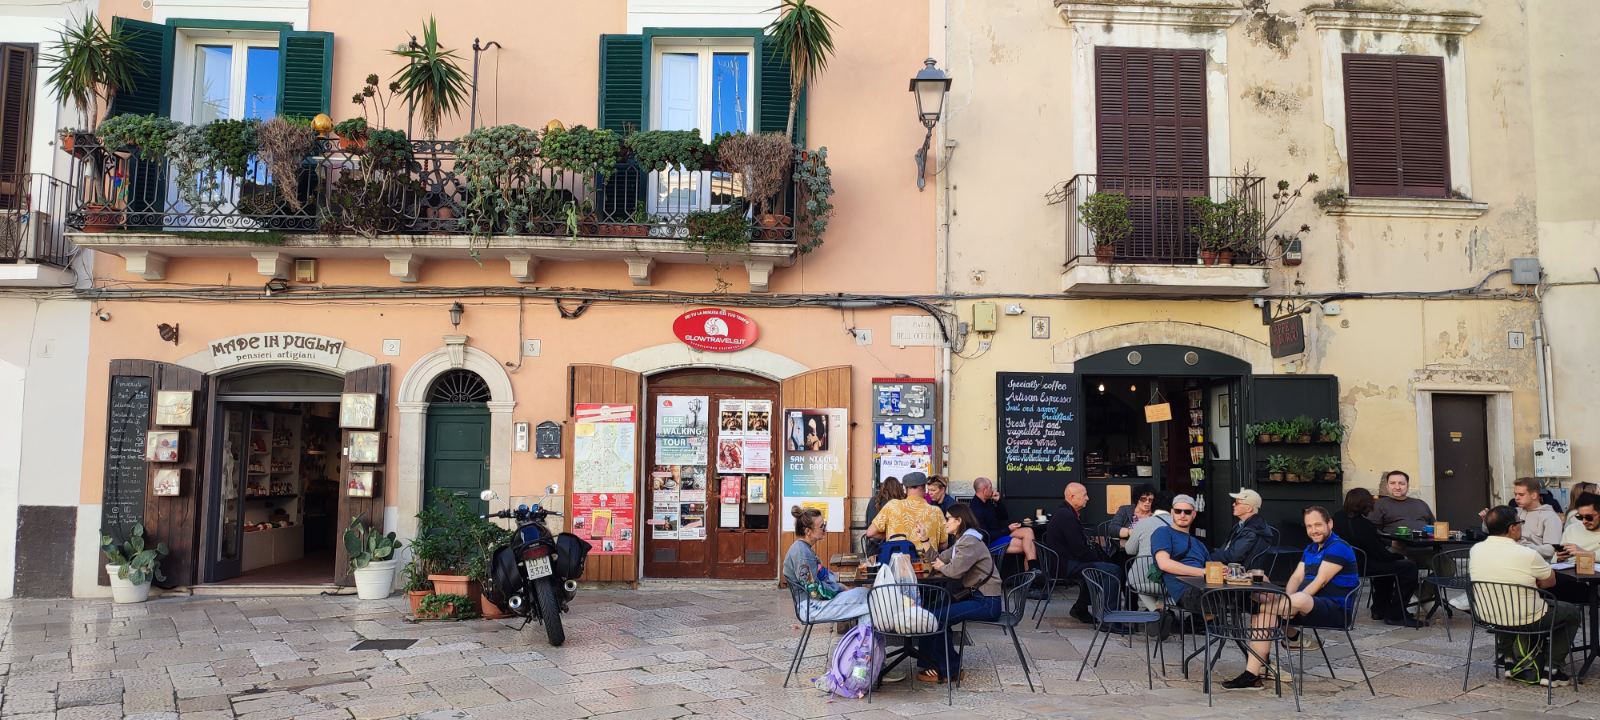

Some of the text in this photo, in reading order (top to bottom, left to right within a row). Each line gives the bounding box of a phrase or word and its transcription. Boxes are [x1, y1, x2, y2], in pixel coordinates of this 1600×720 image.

[684, 334, 746, 345] SLOWTRAVELS.IT
[211, 334, 342, 357] MADE IN PUGLIA
[236, 349, 316, 362] pensieri artigiani
[1042, 379, 1067, 391] coffee
[1005, 391, 1072, 405] Artisan Espresso
[1022, 404, 1034, 412] and
[663, 416, 684, 424] FREE
[1005, 417, 1026, 428] Fresh
[1046, 420, 1061, 429] and
[662, 427, 702, 435] WALKING
[662, 438, 686, 446] TOUR
[1006, 437, 1033, 447] Organic
[790, 455, 805, 463] SAN
[790, 463, 804, 471] DEI
